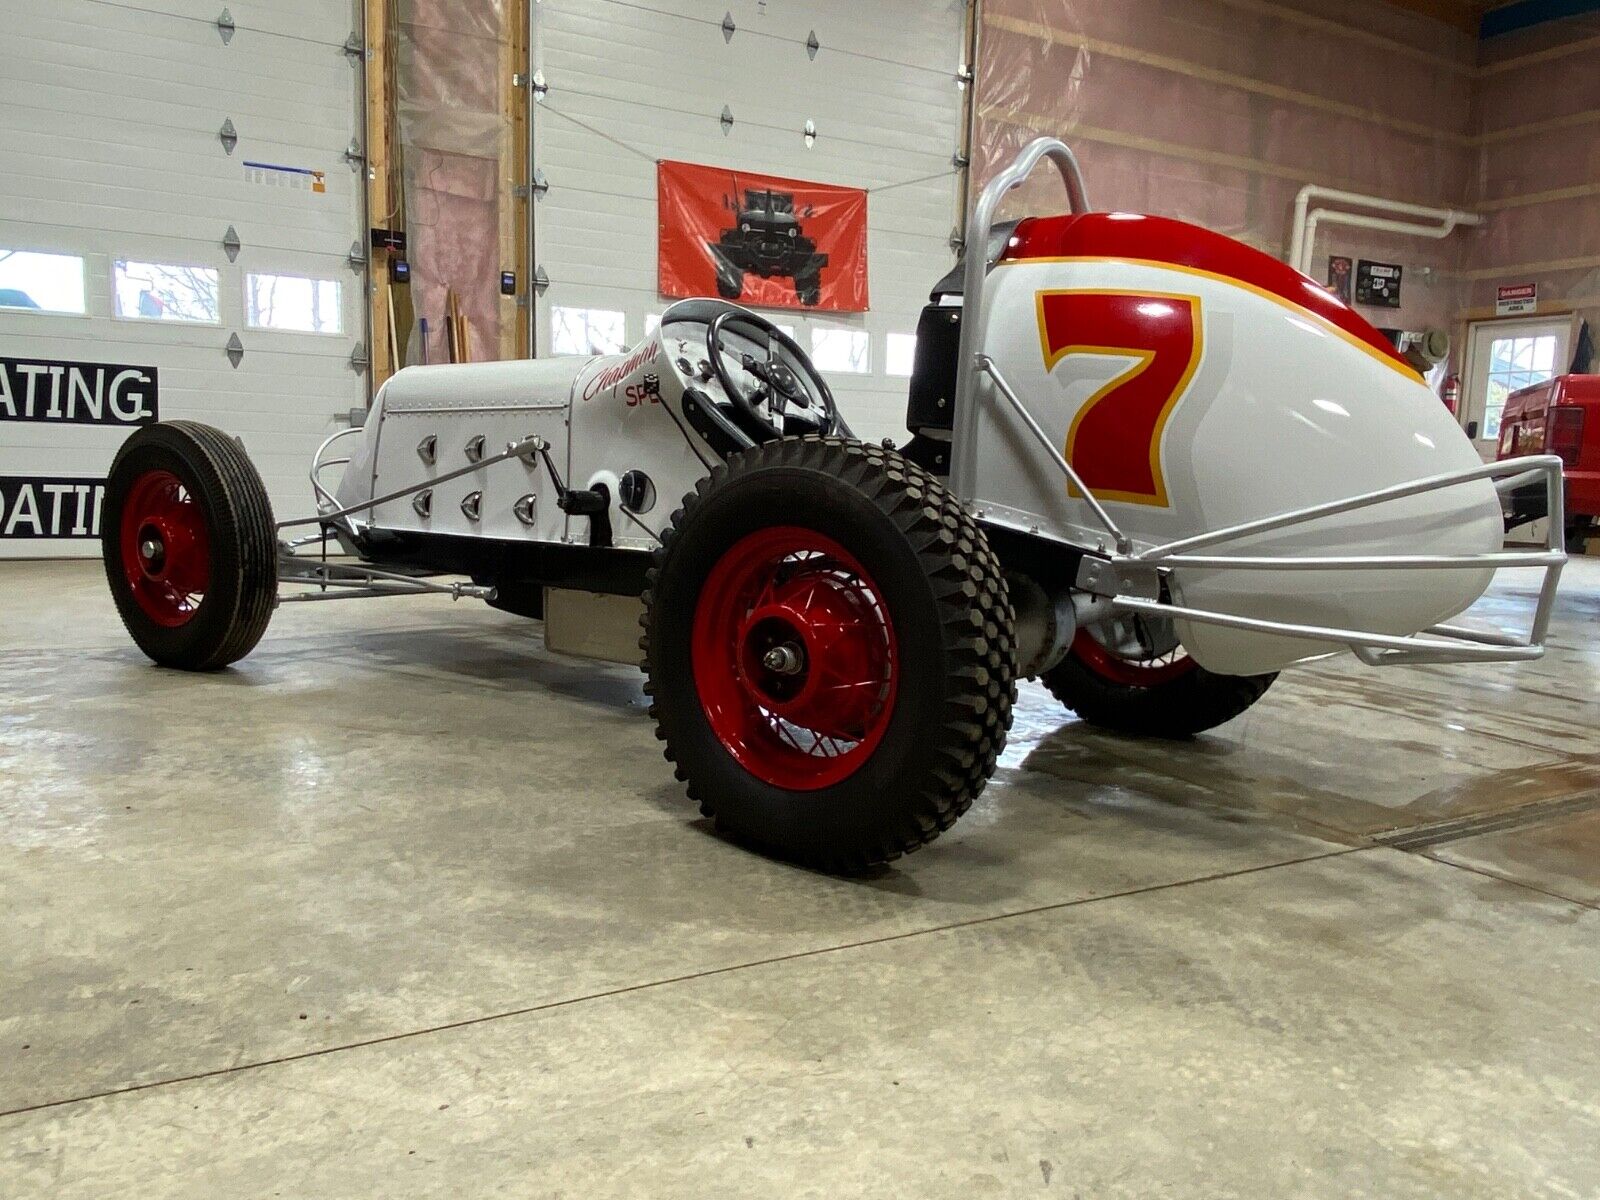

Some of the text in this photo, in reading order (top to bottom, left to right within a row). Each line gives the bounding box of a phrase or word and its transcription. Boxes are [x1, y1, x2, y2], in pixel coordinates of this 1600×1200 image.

[1501, 287, 1532, 297] DANGER
[1034, 288, 1204, 508] 7
[0, 483, 105, 536] ATI
